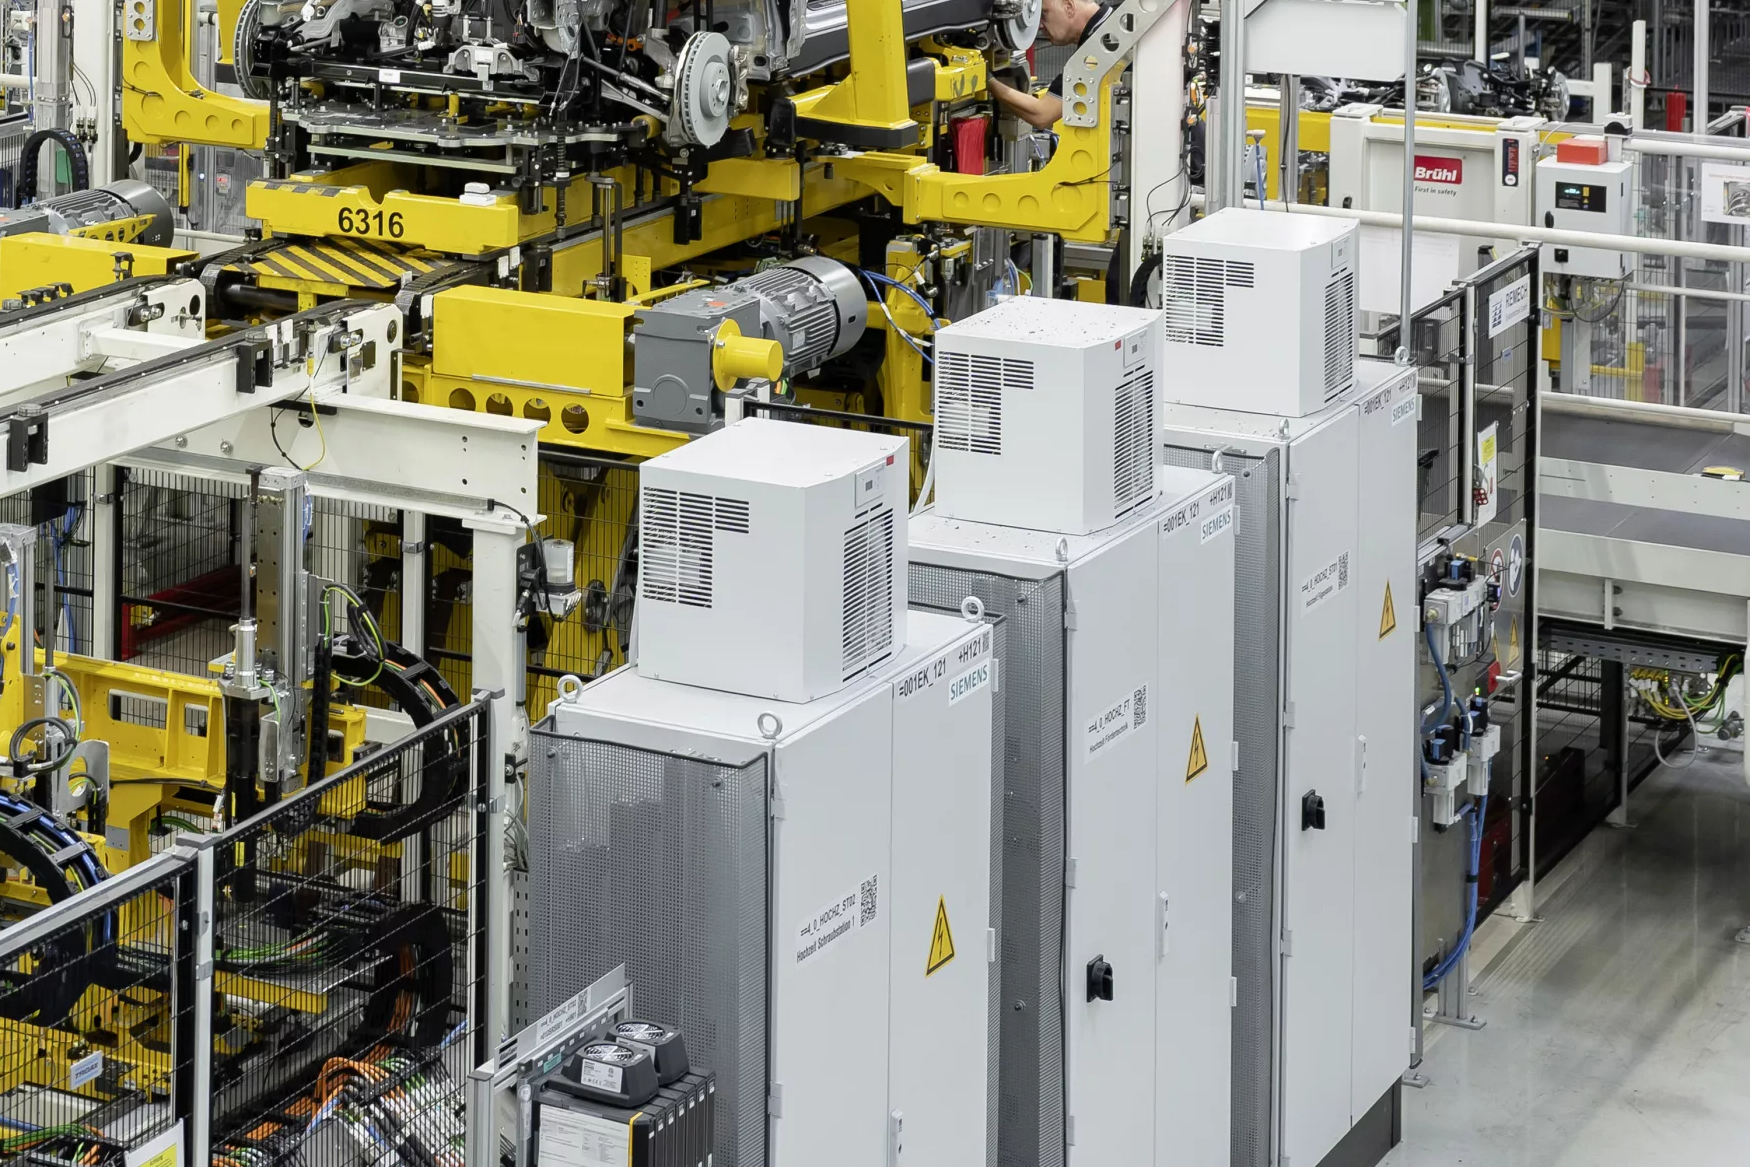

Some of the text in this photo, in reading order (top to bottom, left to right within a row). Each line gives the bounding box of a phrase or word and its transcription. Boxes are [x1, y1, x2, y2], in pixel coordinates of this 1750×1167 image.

[1414, 166, 1458, 182] Brühl
[1414, 185, 1429, 194] First
[1437, 188, 1457, 197] safety
[338, 207, 404, 238] 6316
[1392, 397, 1415, 422] SIEMENS
[1163, 485, 1227, 533] =001EK_121 +H121
[1202, 509, 1231, 540] SIEMENS
[899, 637, 982, 697] =001EK_121 +H121
[950, 664, 988, 701] SIEMENS
[796, 940, 817, 964] Hochzeit
